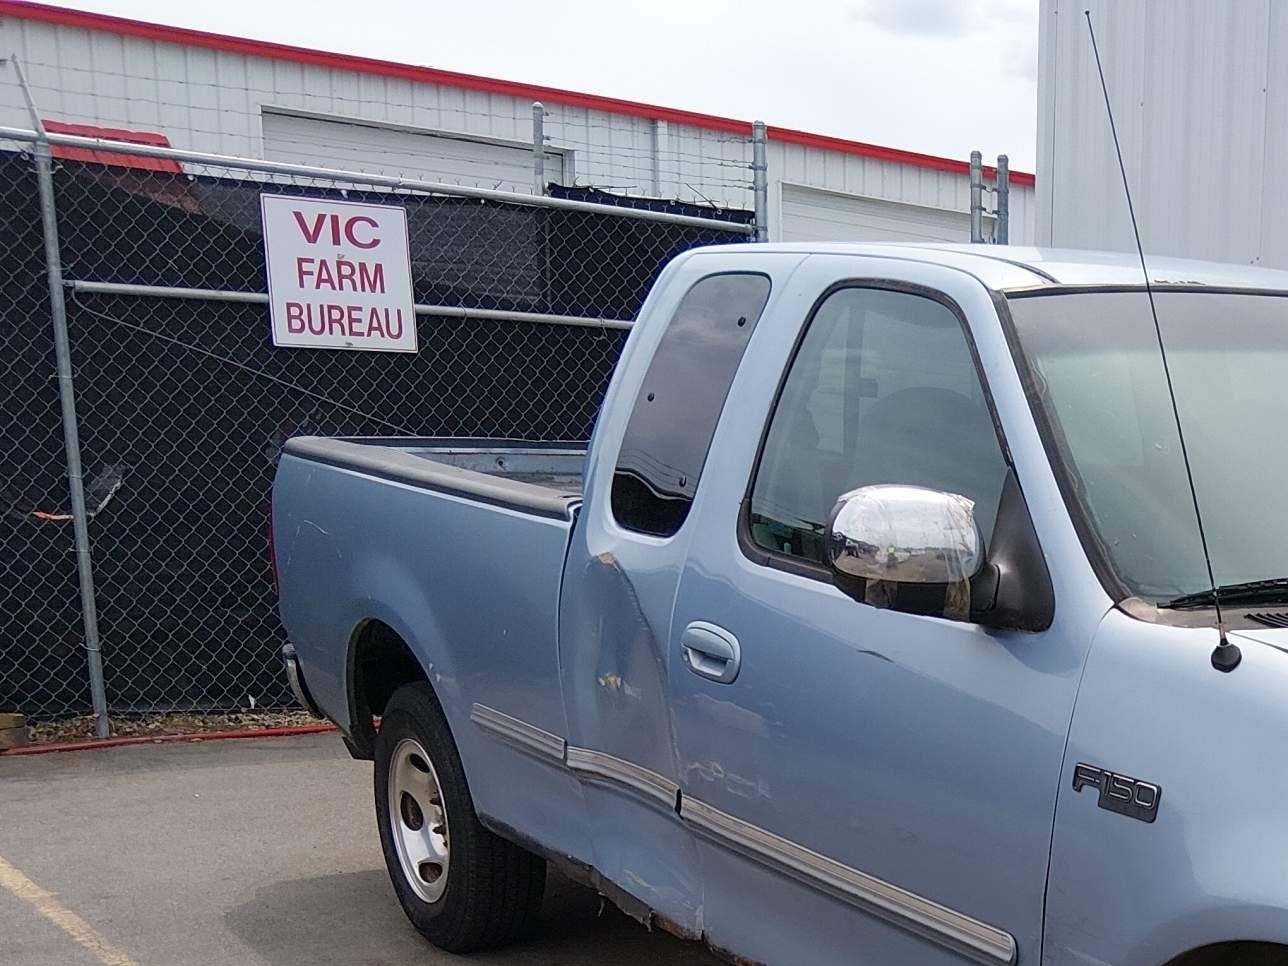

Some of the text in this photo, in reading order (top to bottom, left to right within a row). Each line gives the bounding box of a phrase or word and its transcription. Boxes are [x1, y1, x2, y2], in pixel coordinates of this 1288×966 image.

[292, 210, 382, 249] VIC
[296, 256, 386, 294] FARM
[285, 302, 404, 340] BUREAU
